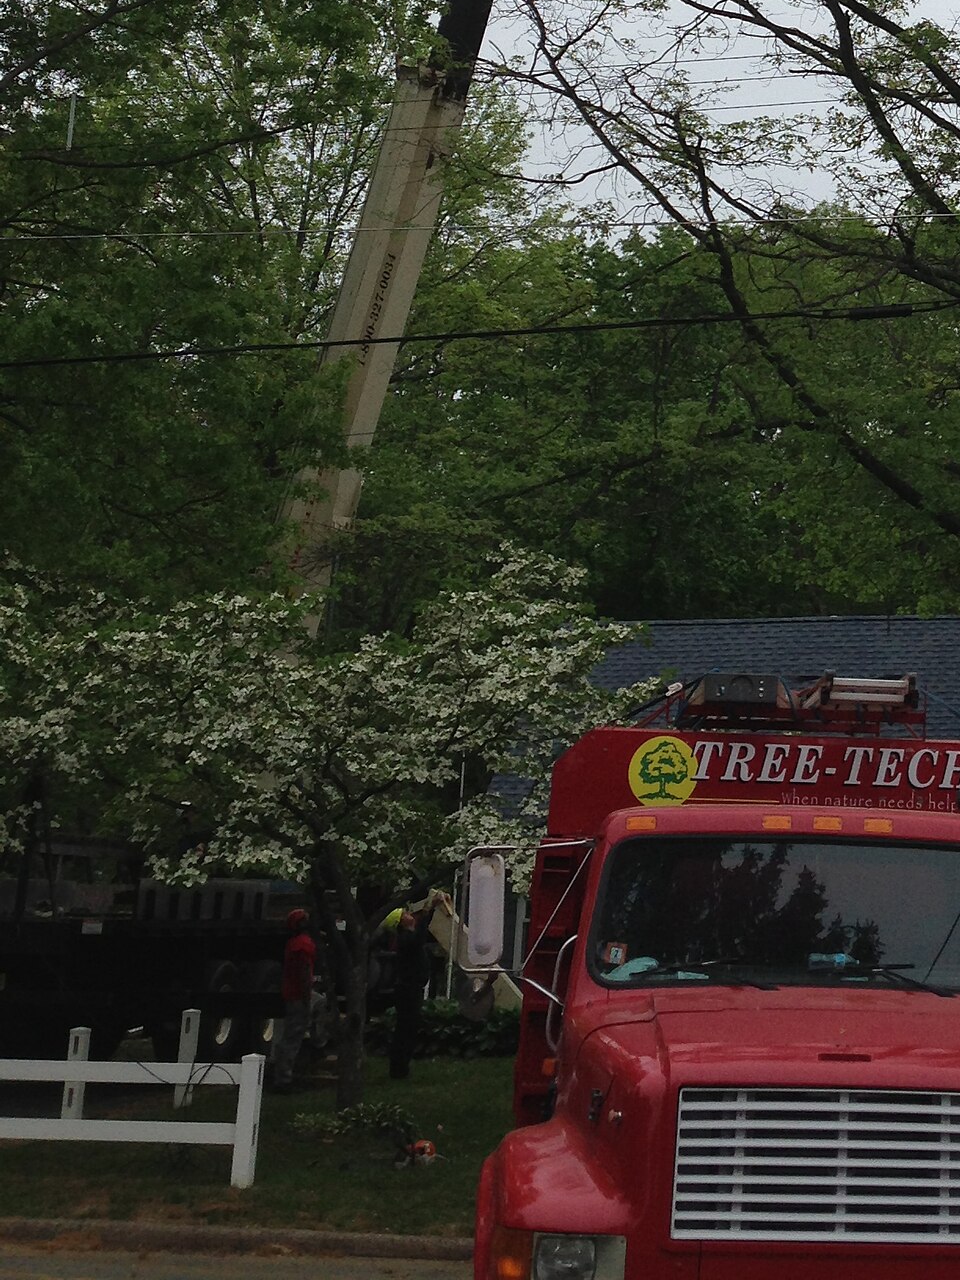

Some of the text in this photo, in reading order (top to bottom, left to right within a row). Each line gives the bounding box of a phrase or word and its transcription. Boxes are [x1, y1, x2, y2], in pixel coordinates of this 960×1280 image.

[781, 788, 819, 806] When
[824, 794, 873, 808] nature
[878, 789, 923, 809] needs
